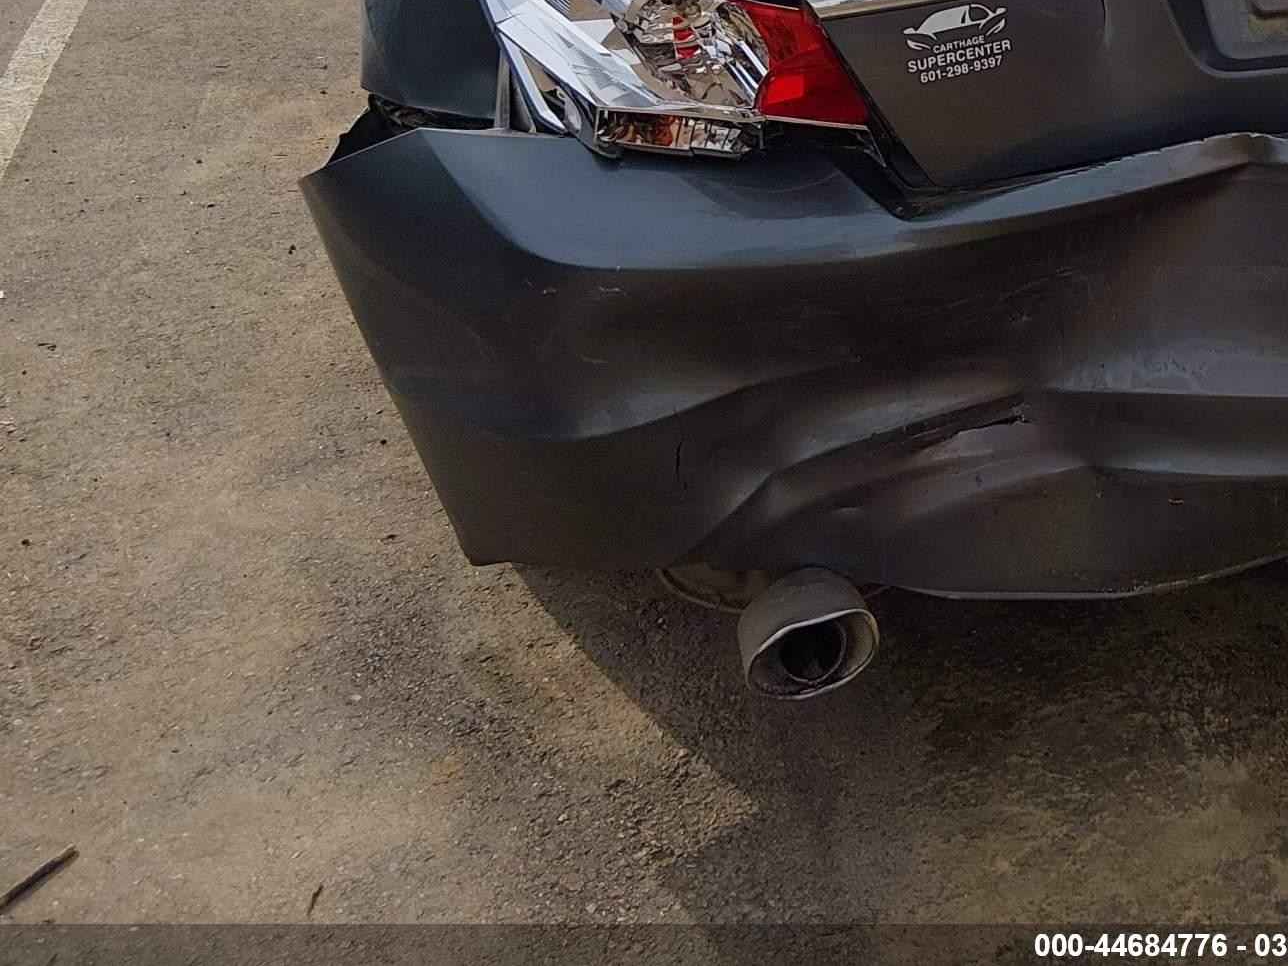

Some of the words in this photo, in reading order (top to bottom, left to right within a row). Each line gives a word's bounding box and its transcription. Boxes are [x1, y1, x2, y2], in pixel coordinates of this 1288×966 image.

[907, 39, 1012, 73] SUPERCENTER
[933, 35, 985, 54] CARTHAGE
[920, 55, 1003, 83] 601-298-9397
